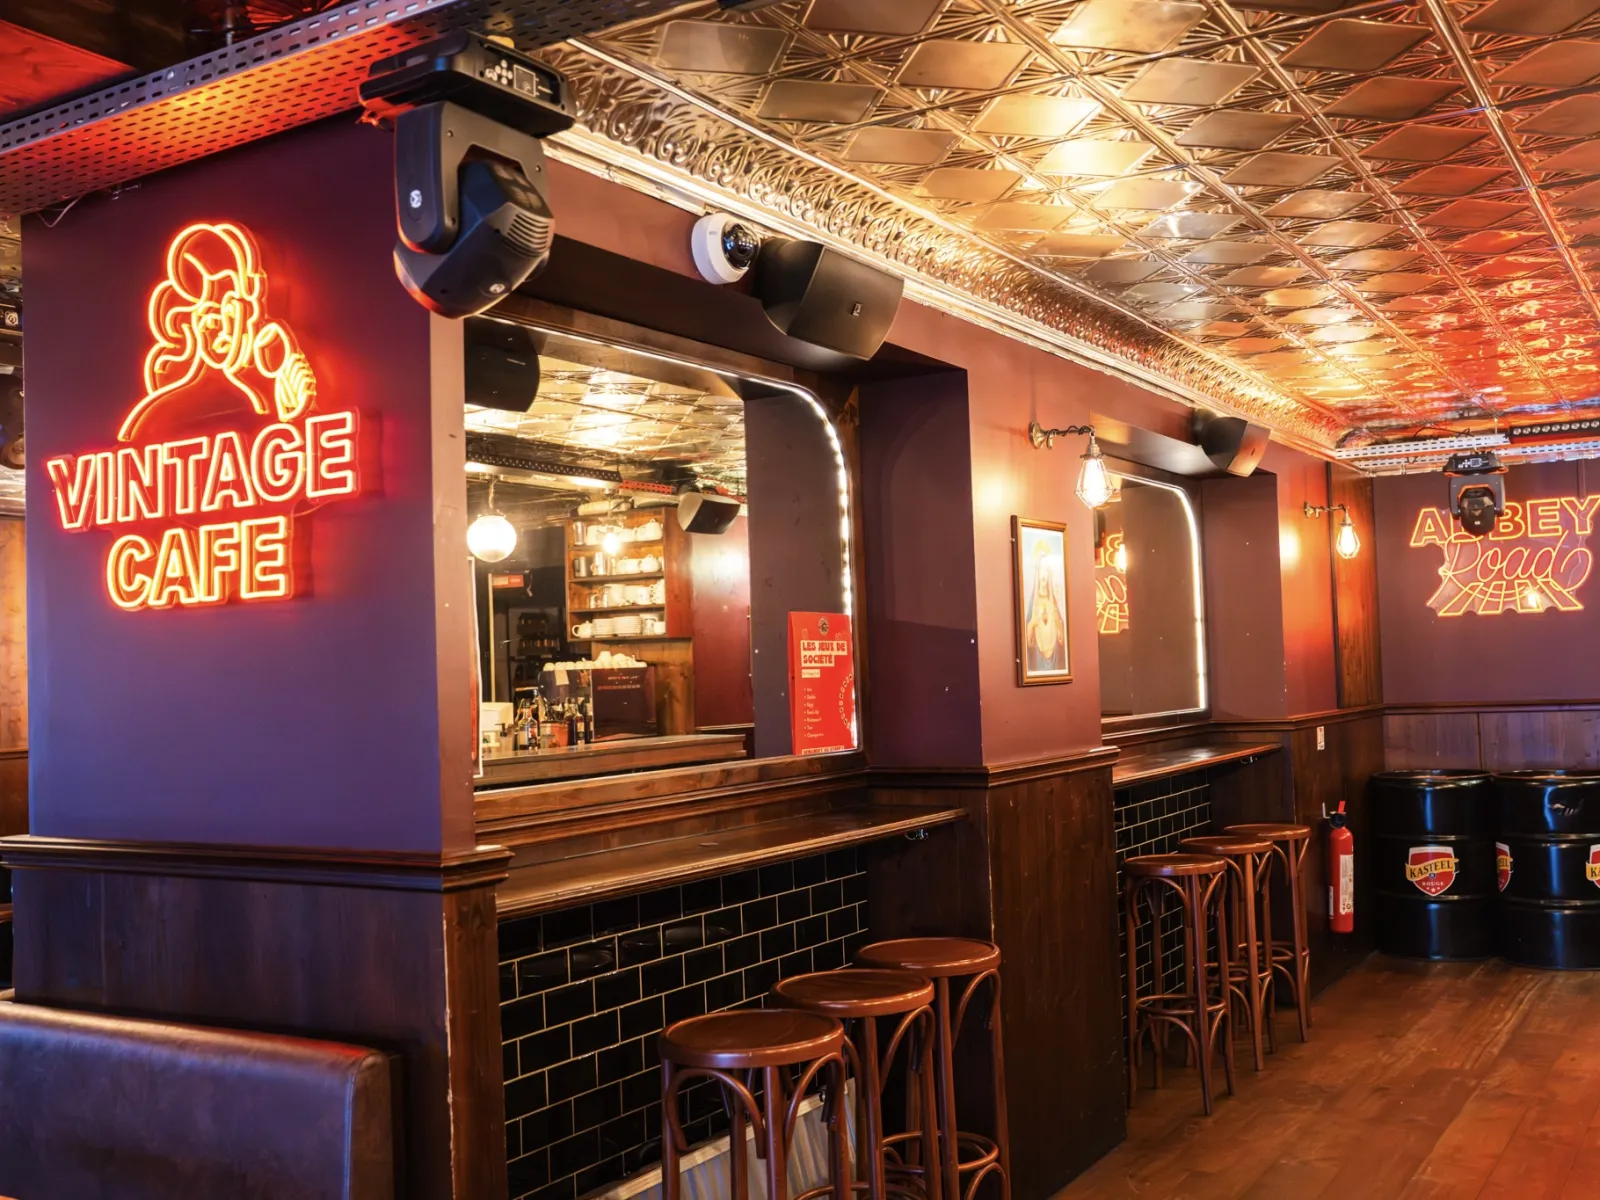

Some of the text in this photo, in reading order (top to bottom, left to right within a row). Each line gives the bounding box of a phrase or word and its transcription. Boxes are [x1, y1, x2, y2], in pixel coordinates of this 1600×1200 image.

[47, 409, 359, 532] VINTAGE
[106, 515, 292, 609] CAFE
[1426, 530, 1592, 607] Road
[802, 641, 846, 652] LES JEUX DE
[1409, 859, 1453, 879] KASTEEL
